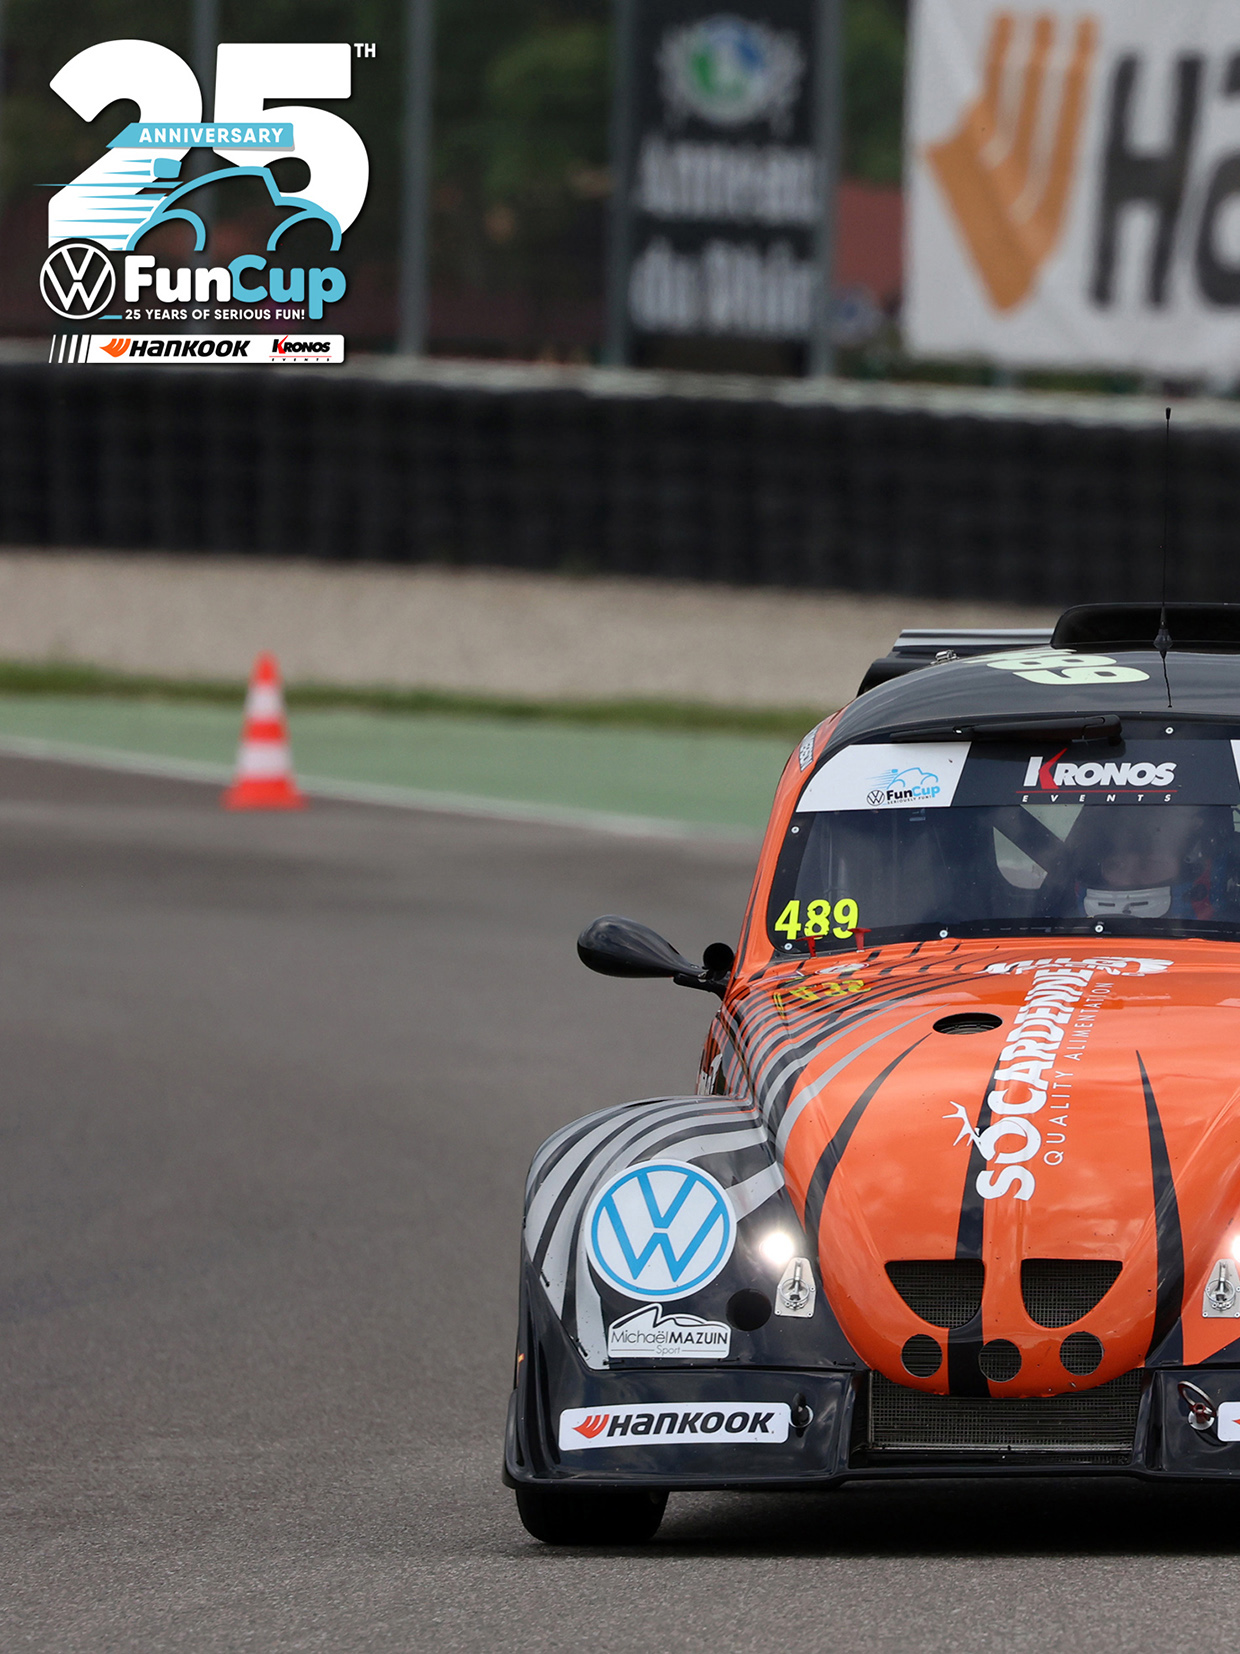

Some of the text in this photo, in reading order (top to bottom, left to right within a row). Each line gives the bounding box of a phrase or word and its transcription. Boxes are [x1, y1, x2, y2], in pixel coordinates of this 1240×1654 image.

[1023, 748, 1177, 790] KRONOS
[887, 785, 940, 800] FunCup
[1022, 794, 1171, 803] EVENTS
[774, 898, 859, 940] 489
[975, 968, 1094, 1201] SOCARDENNE
[1044, 982, 1115, 1166] QUALITY ALIMENTATION
[656, 1345, 681, 1356] Sport
